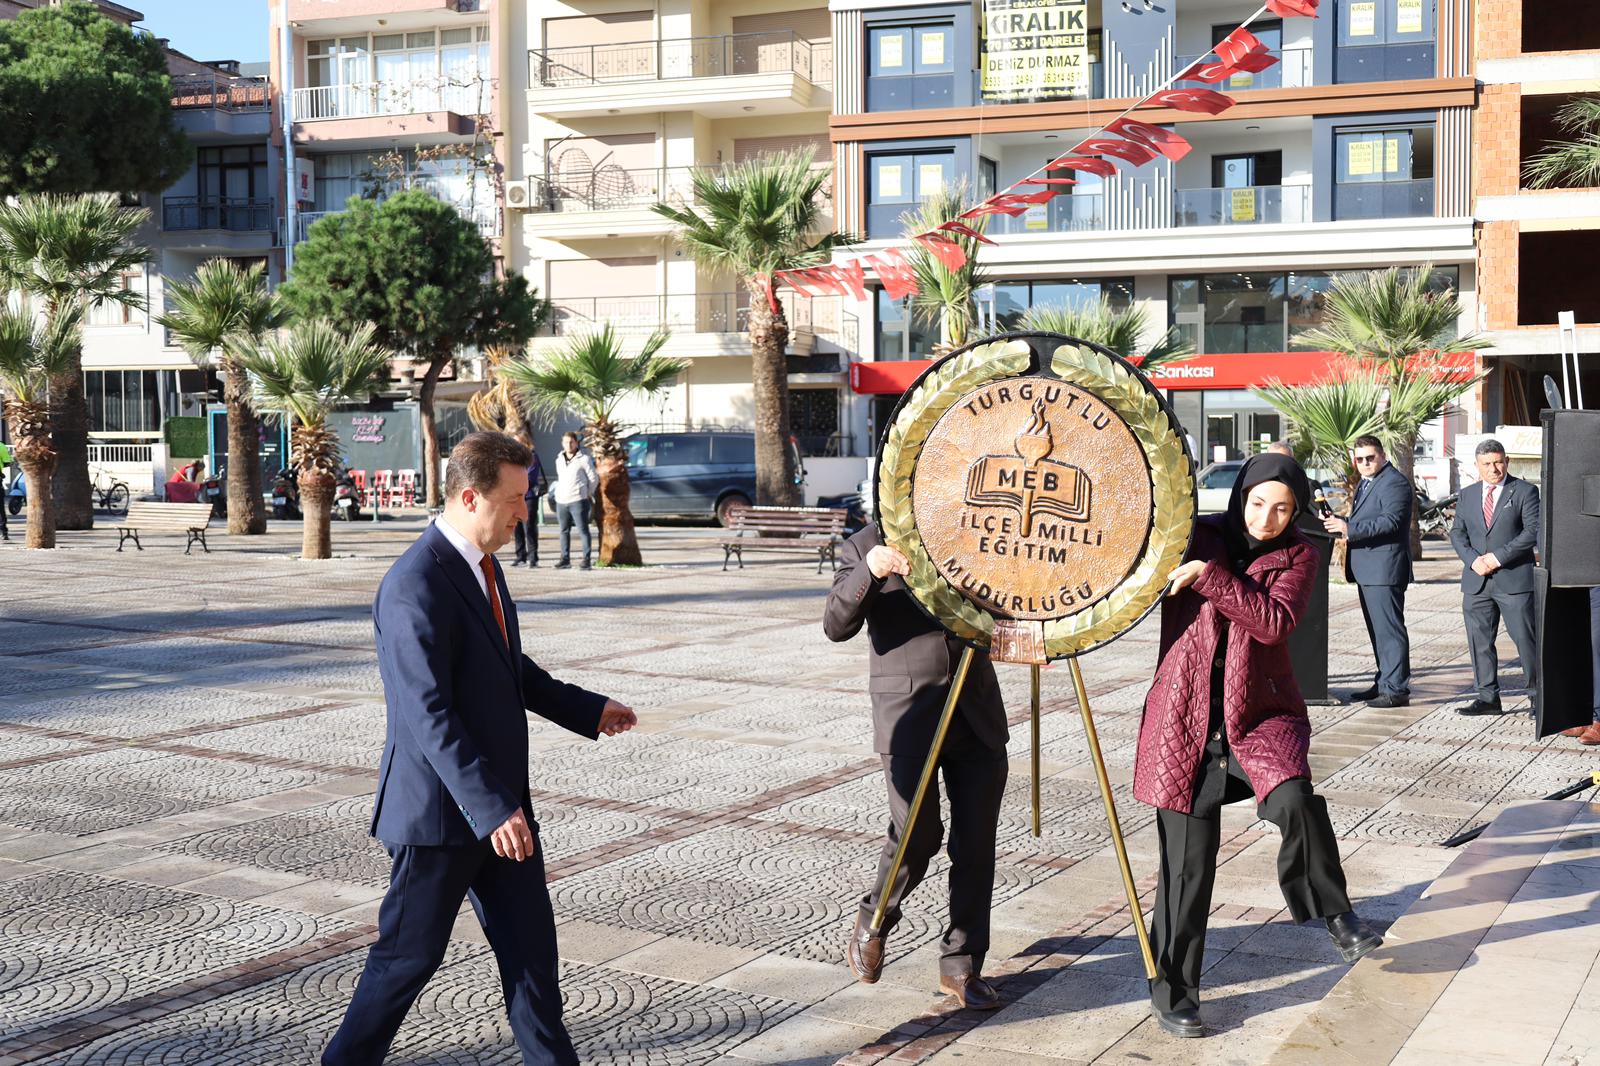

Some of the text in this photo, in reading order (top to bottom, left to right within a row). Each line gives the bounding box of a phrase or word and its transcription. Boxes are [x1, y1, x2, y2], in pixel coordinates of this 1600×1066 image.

[989, 54, 1080, 72] DENİZ DURMAZ
[1155, 364, 1215, 378] Bankası
[963, 383, 1112, 431] TURGUTLU
[998, 468, 1059, 491] MEB
